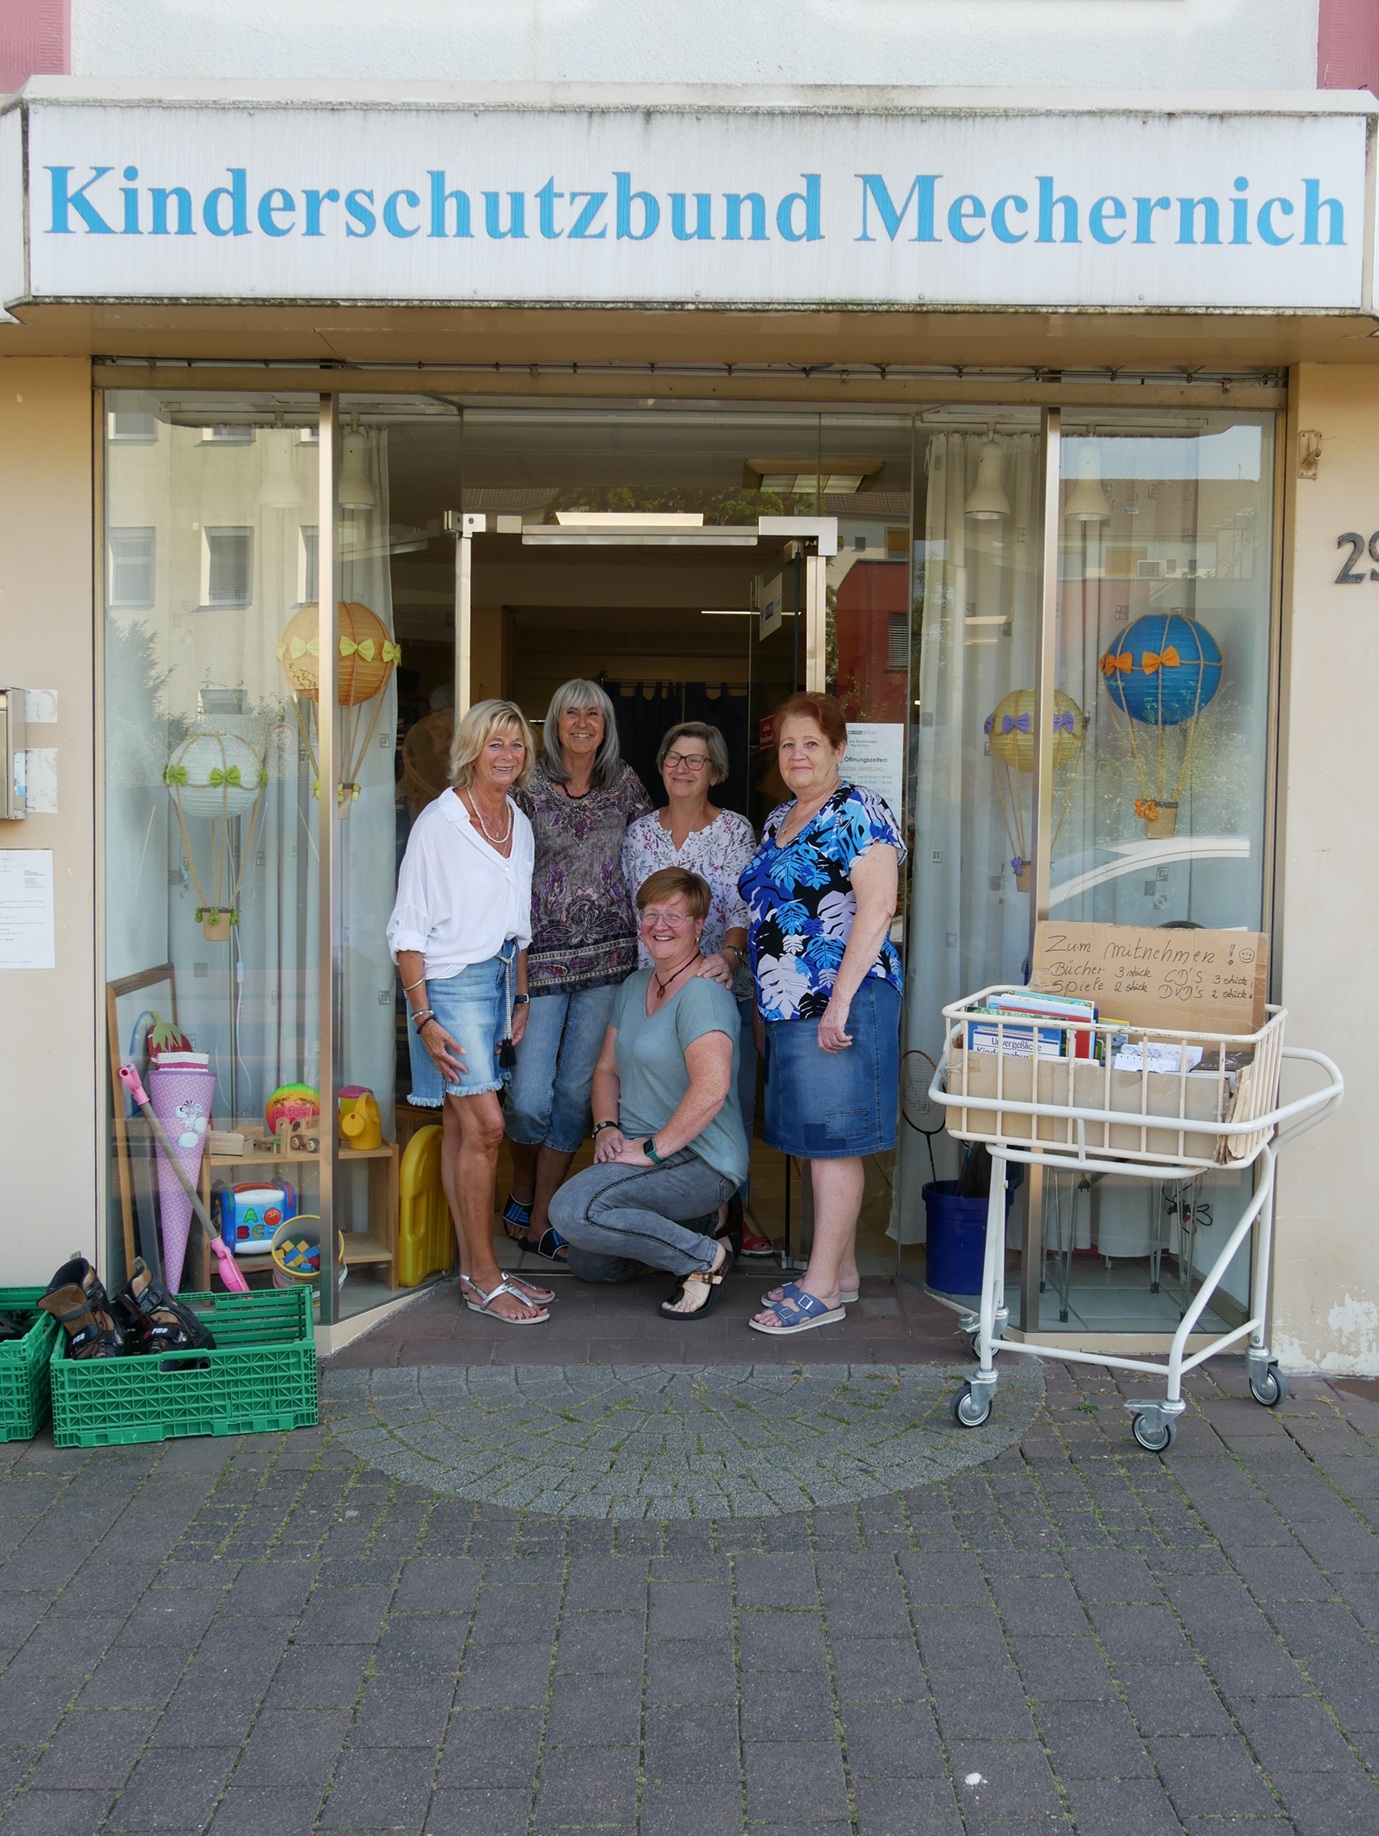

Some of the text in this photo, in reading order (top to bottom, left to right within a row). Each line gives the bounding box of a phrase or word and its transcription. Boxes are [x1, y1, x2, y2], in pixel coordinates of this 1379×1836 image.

[43, 165, 1348, 247] Kinderschutzbund Mechernich
[1045, 934, 1092, 953] Zum
[1048, 959, 1105, 977] Bücher
[1115, 966, 1124, 978] 3
[1212, 974, 1221, 985] 3
[1045, 978, 1104, 998] Spiele
[1113, 981, 1122, 992] 2
[1211, 989, 1218, 999] 2
[243, 1207, 259, 1223] A
